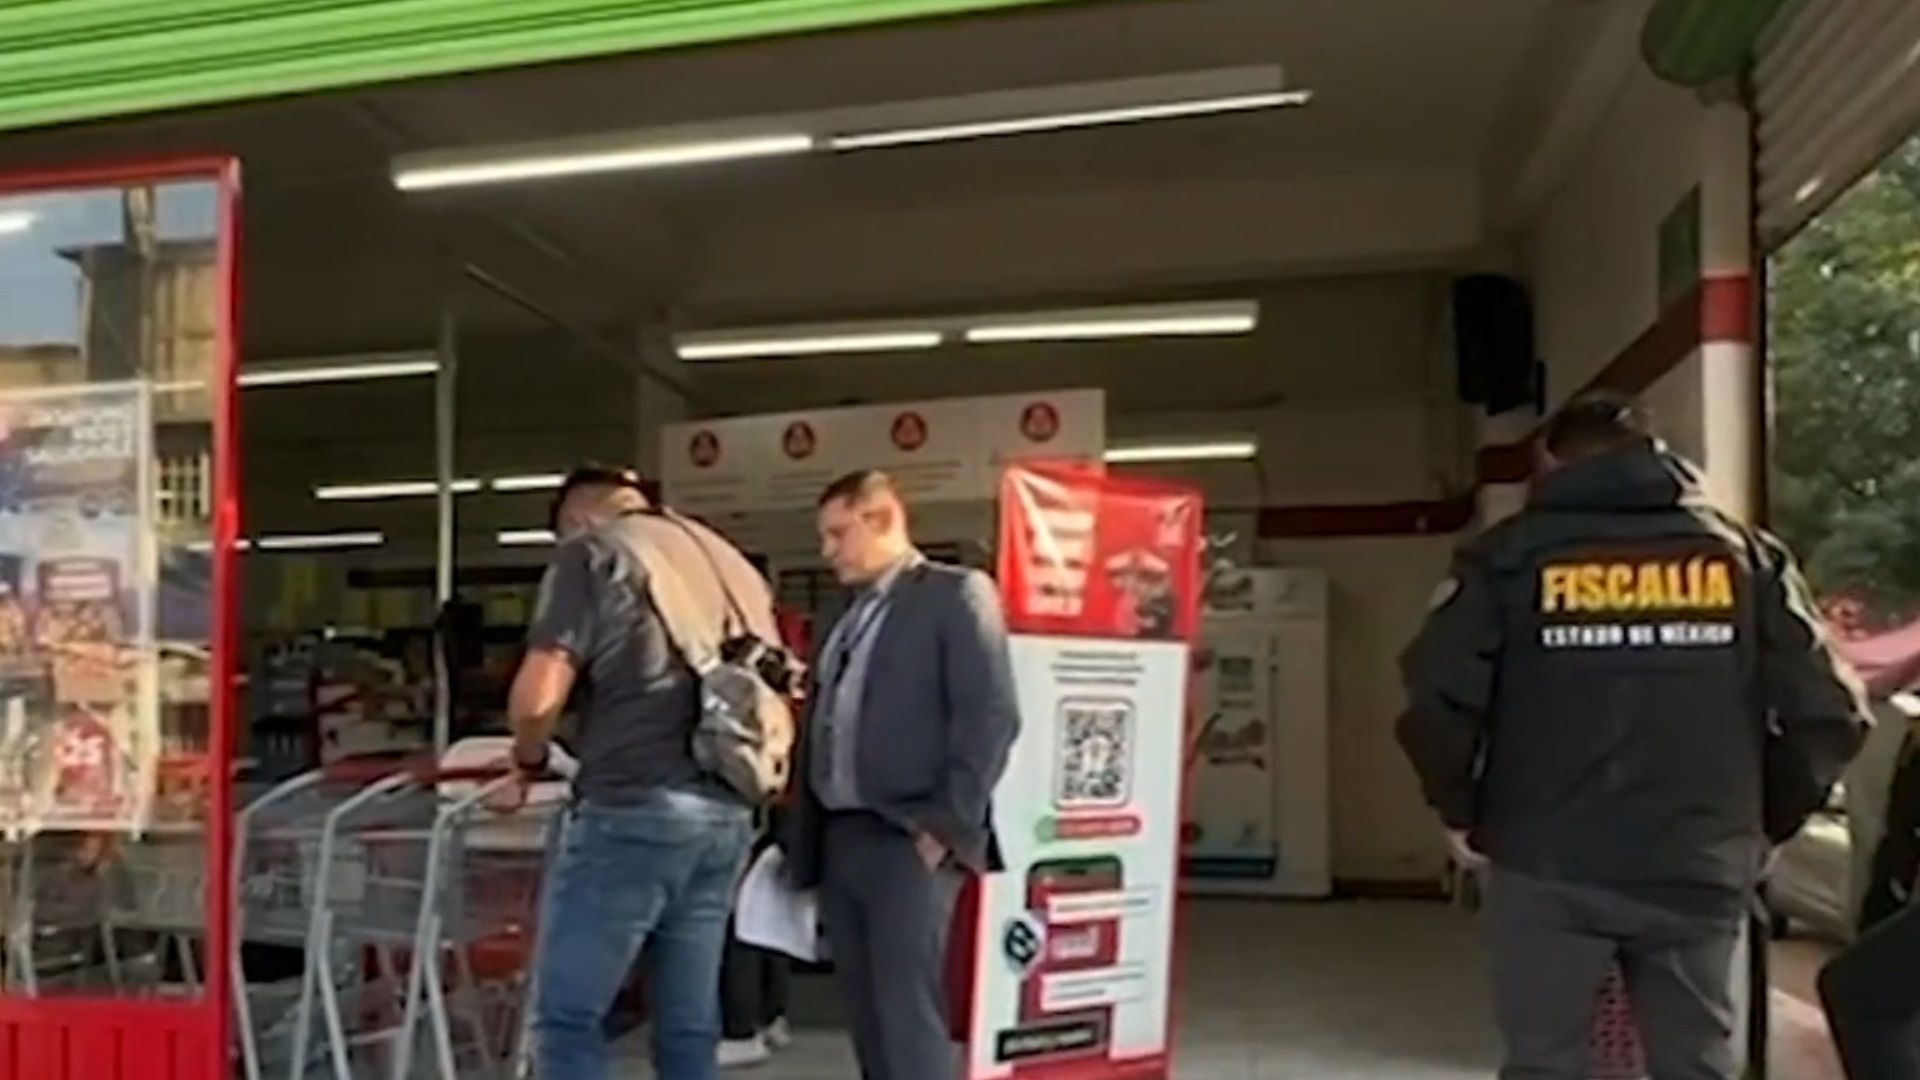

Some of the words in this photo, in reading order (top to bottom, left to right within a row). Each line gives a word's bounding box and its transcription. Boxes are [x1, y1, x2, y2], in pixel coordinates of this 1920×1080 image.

[1541, 556, 1734, 612] FISCALÍA
[1542, 624, 1623, 647] ESTADO
[1629, 624, 1655, 646] DE
[1660, 622, 1734, 645] MÉXICO
